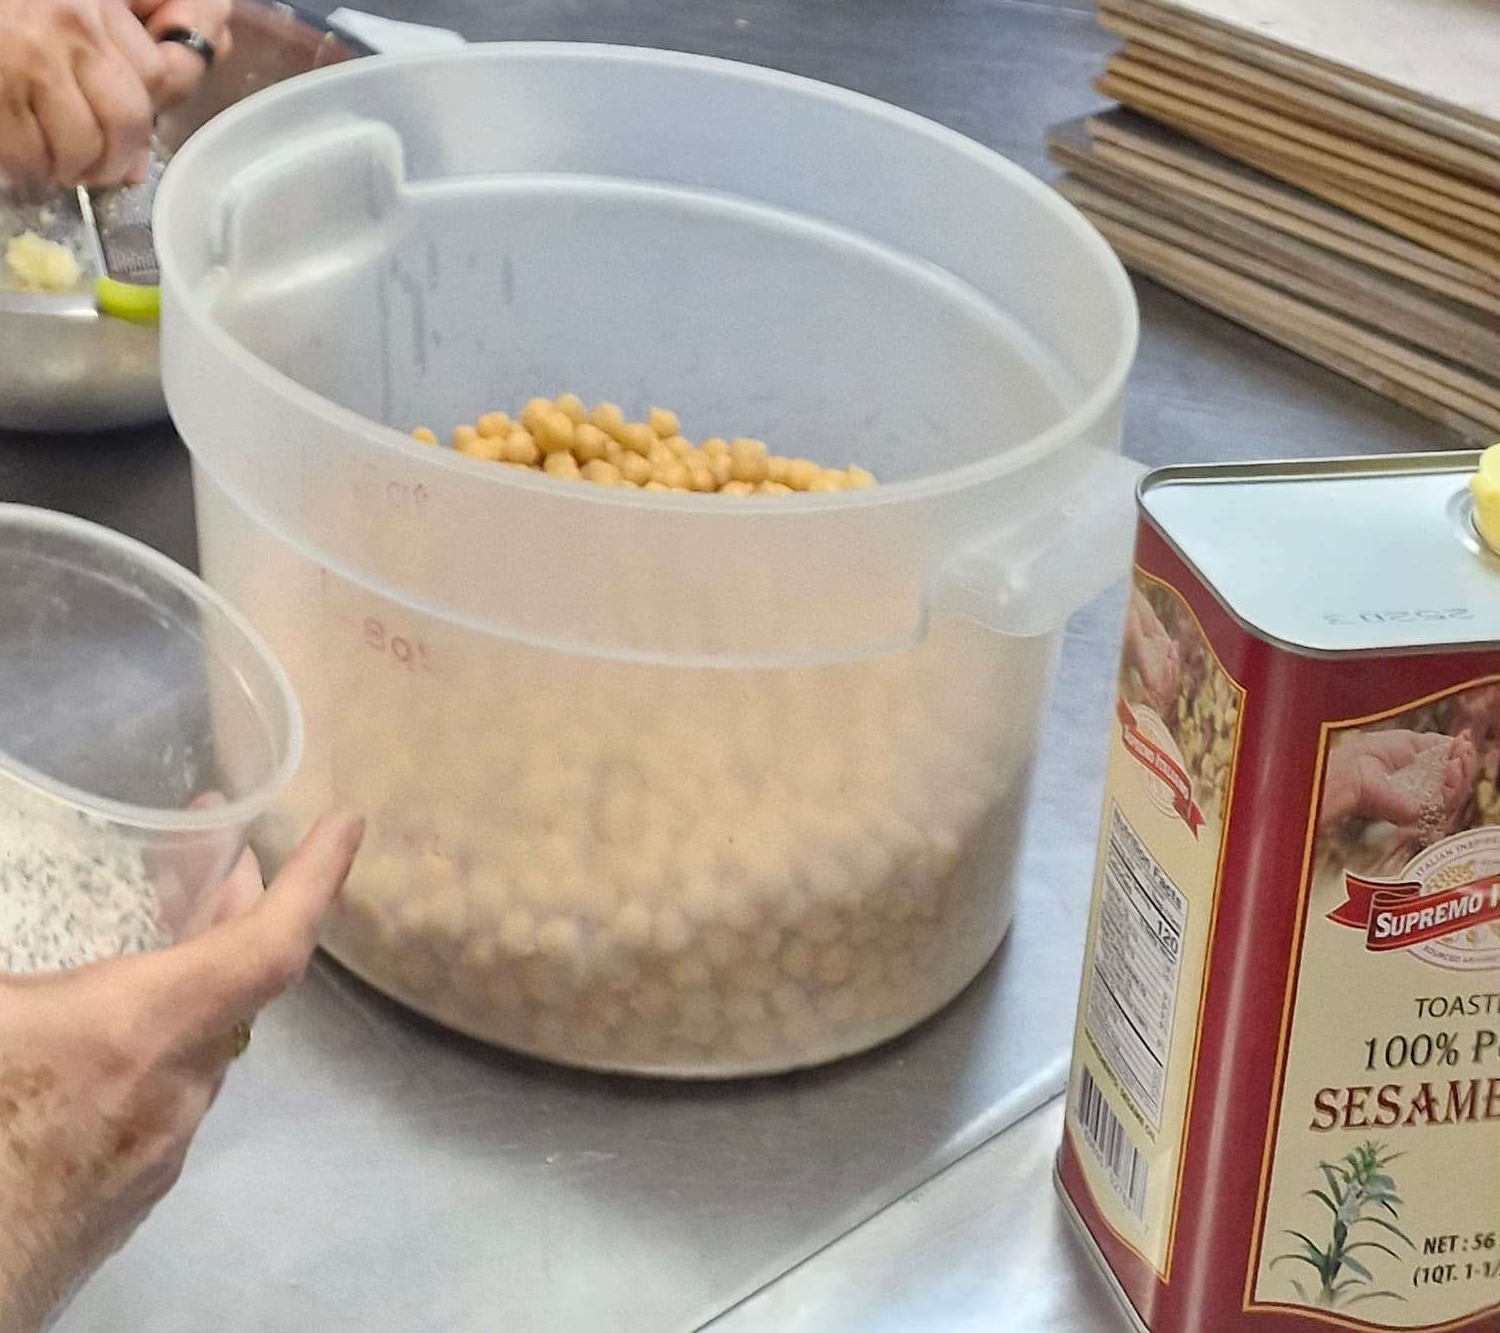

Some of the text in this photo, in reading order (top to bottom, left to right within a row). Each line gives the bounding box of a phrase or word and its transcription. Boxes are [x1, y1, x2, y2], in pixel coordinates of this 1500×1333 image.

[1416, 846, 1454, 877] ITALIAN
[1375, 891, 1483, 938] SUPREMO
[1157, 919, 1179, 955] 120
[1414, 993, 1500, 1018] TOAST
[1364, 1030, 1500, 1071] 100% P
[1413, 1264, 1458, 1287] (1QT.
